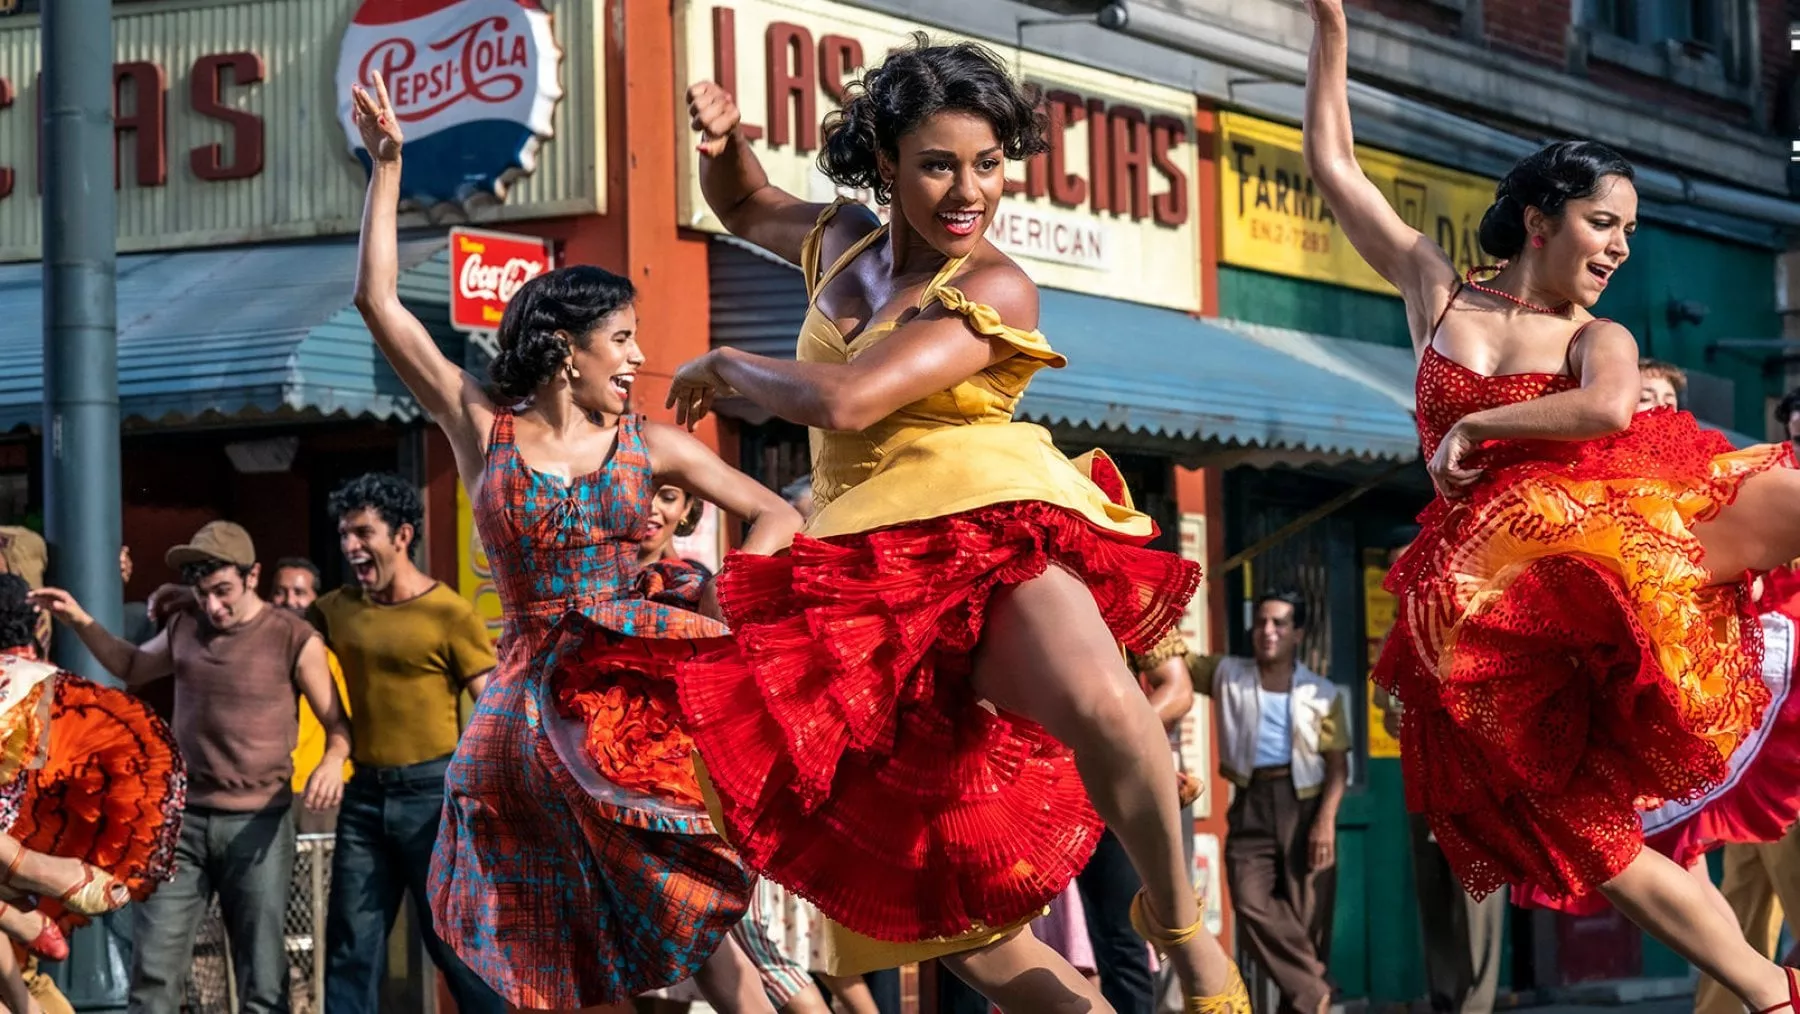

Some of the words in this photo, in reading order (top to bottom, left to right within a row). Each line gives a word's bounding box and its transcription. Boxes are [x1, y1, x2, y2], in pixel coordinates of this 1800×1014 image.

[712, 6, 863, 155] LAS
[1002, 83, 1188, 229] ICIAS
[988, 213, 1102, 260] MERICAN
